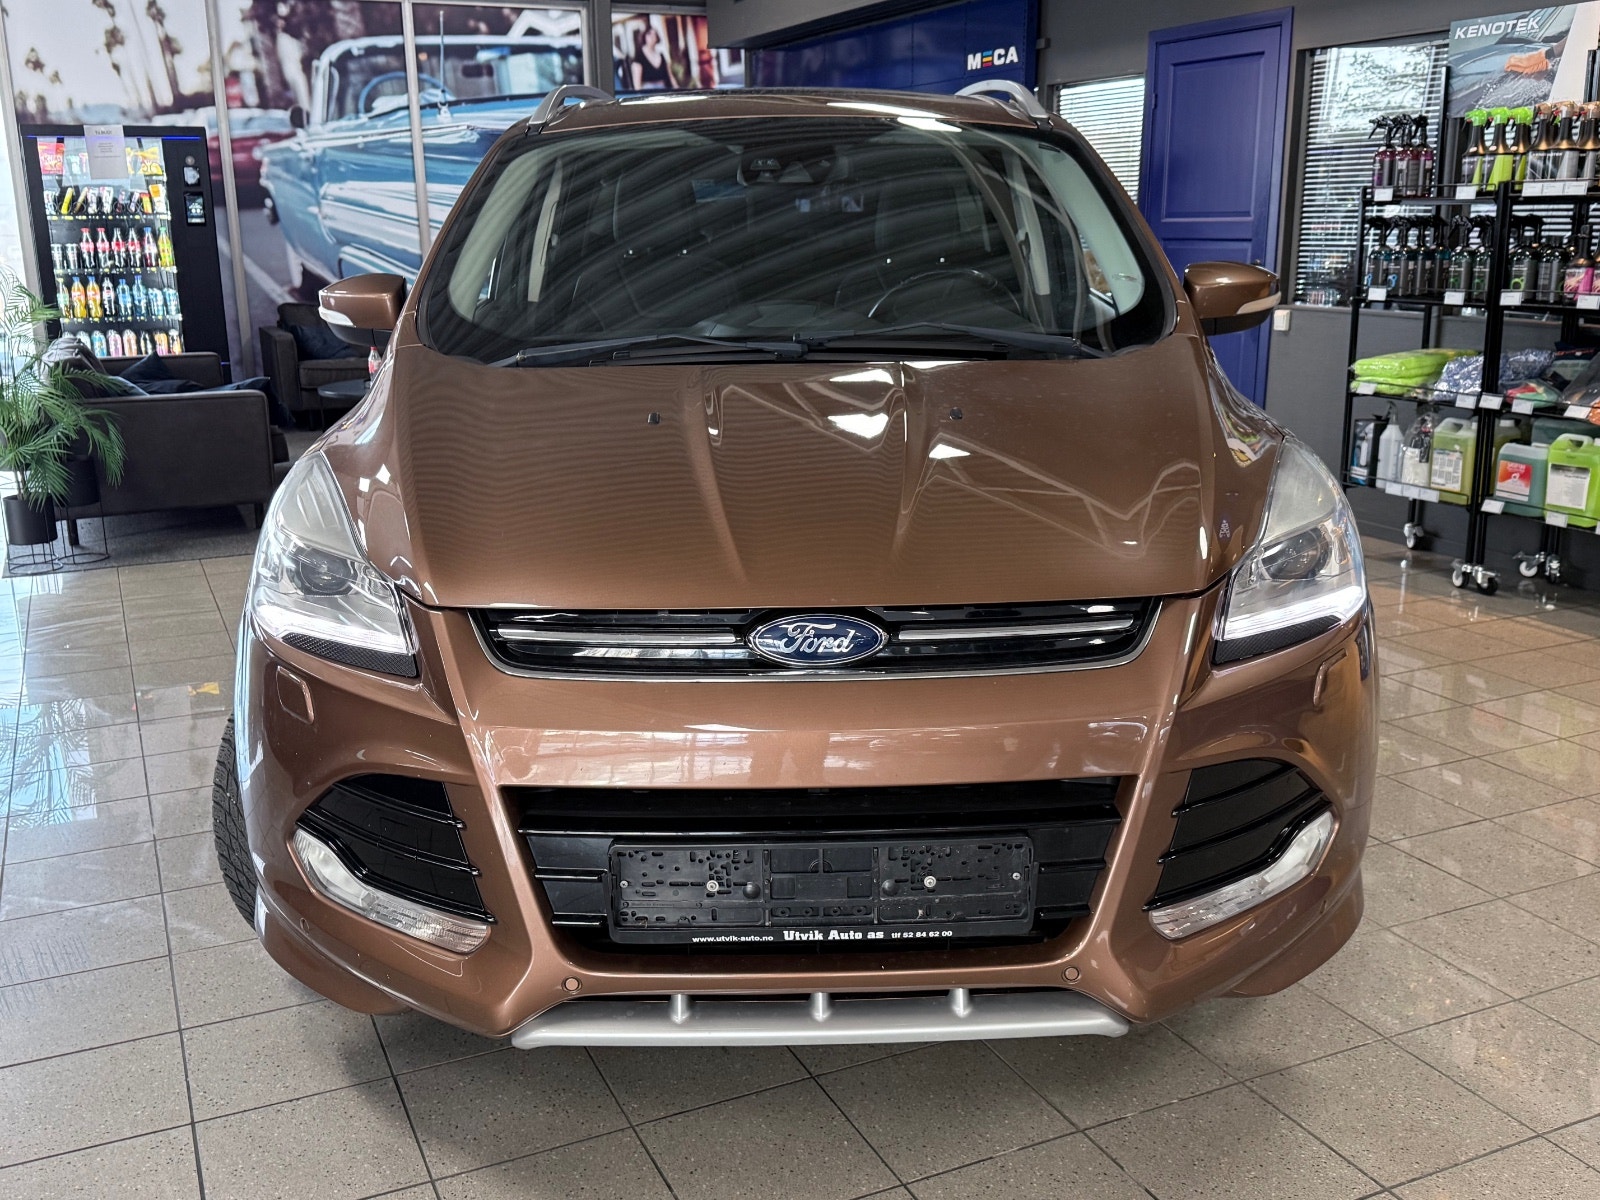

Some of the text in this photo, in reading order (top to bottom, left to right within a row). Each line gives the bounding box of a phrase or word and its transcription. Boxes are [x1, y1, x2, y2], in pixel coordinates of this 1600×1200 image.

[1454, 16, 1541, 39] KENOTEK
[778, 622, 856, 653] Ford
[691, 935, 774, 943] www.utvik-auto.no
[783, 930, 824, 941] Utvik
[828, 929, 863, 940] Auto
[867, 930, 884, 939] as
